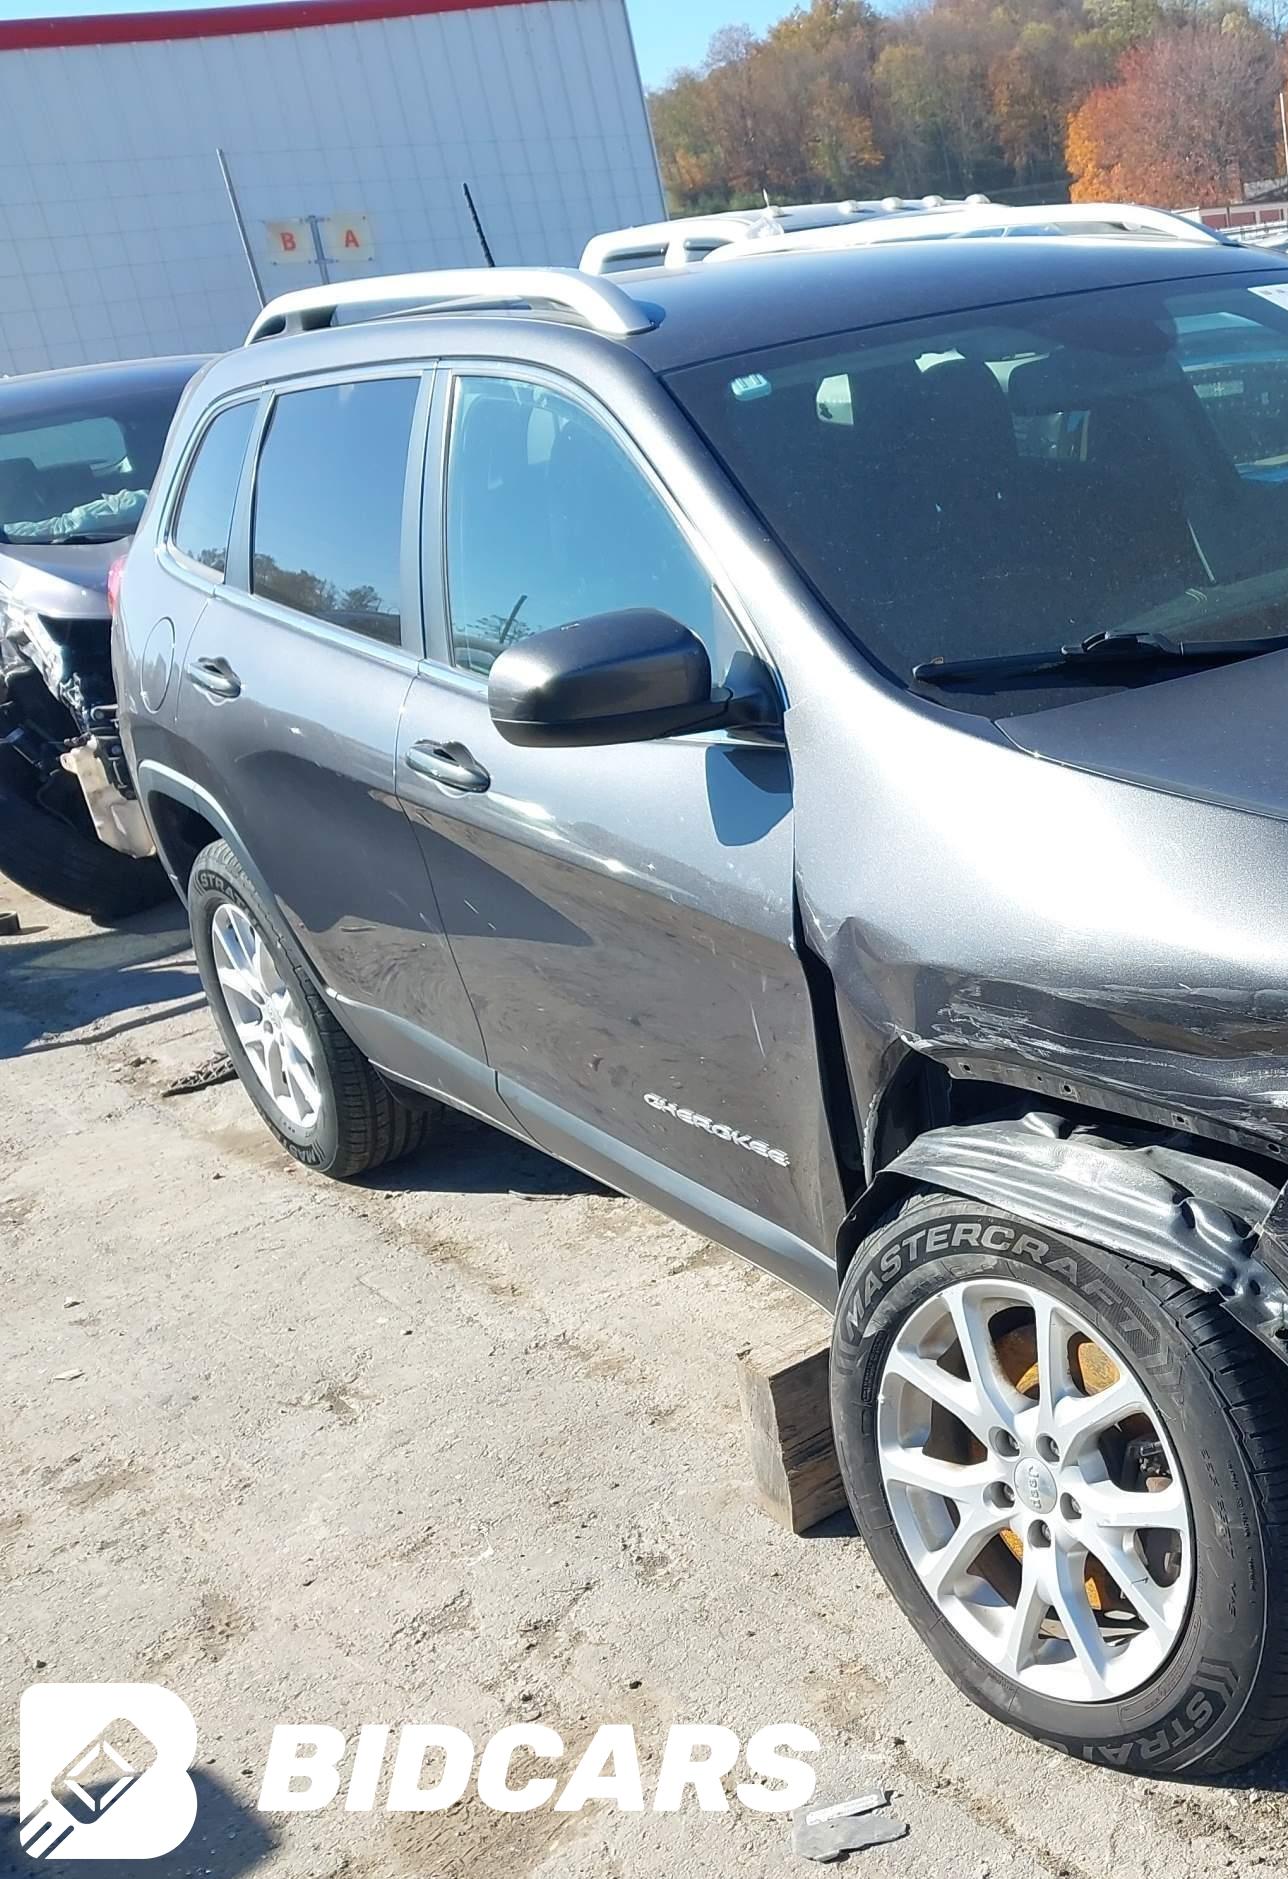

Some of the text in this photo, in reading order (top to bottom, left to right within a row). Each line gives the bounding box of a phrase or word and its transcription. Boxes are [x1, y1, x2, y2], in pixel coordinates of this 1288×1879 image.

[280, 232, 296, 251] B
[344, 229, 360, 248] A
[643, 1092, 790, 1167] CHEROKEE
[847, 1223, 1157, 1341] MASTERCRAFT
